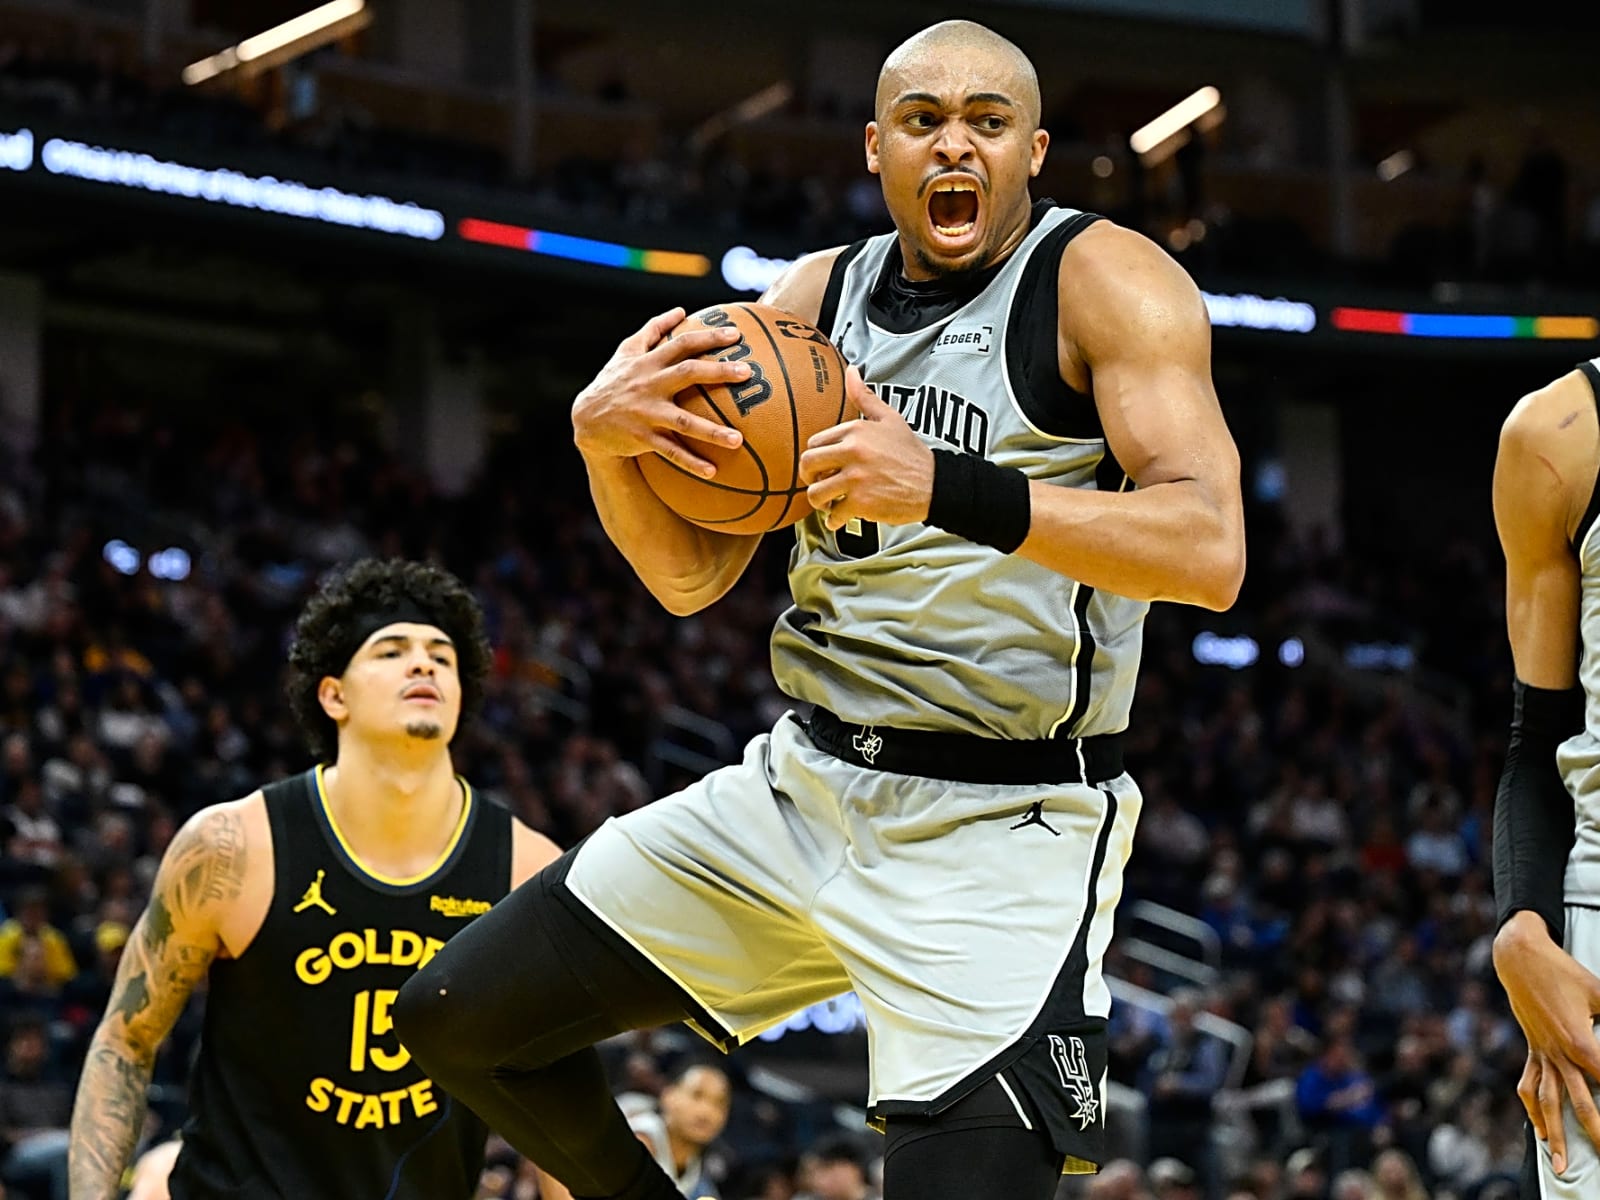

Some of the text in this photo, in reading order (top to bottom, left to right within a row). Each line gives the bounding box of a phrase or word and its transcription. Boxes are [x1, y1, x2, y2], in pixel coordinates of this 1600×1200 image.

[936, 333, 982, 346] LEDGER
[295, 928, 446, 985] GOLD
[350, 989, 412, 1072] 15
[306, 1077, 438, 1129] STATE
